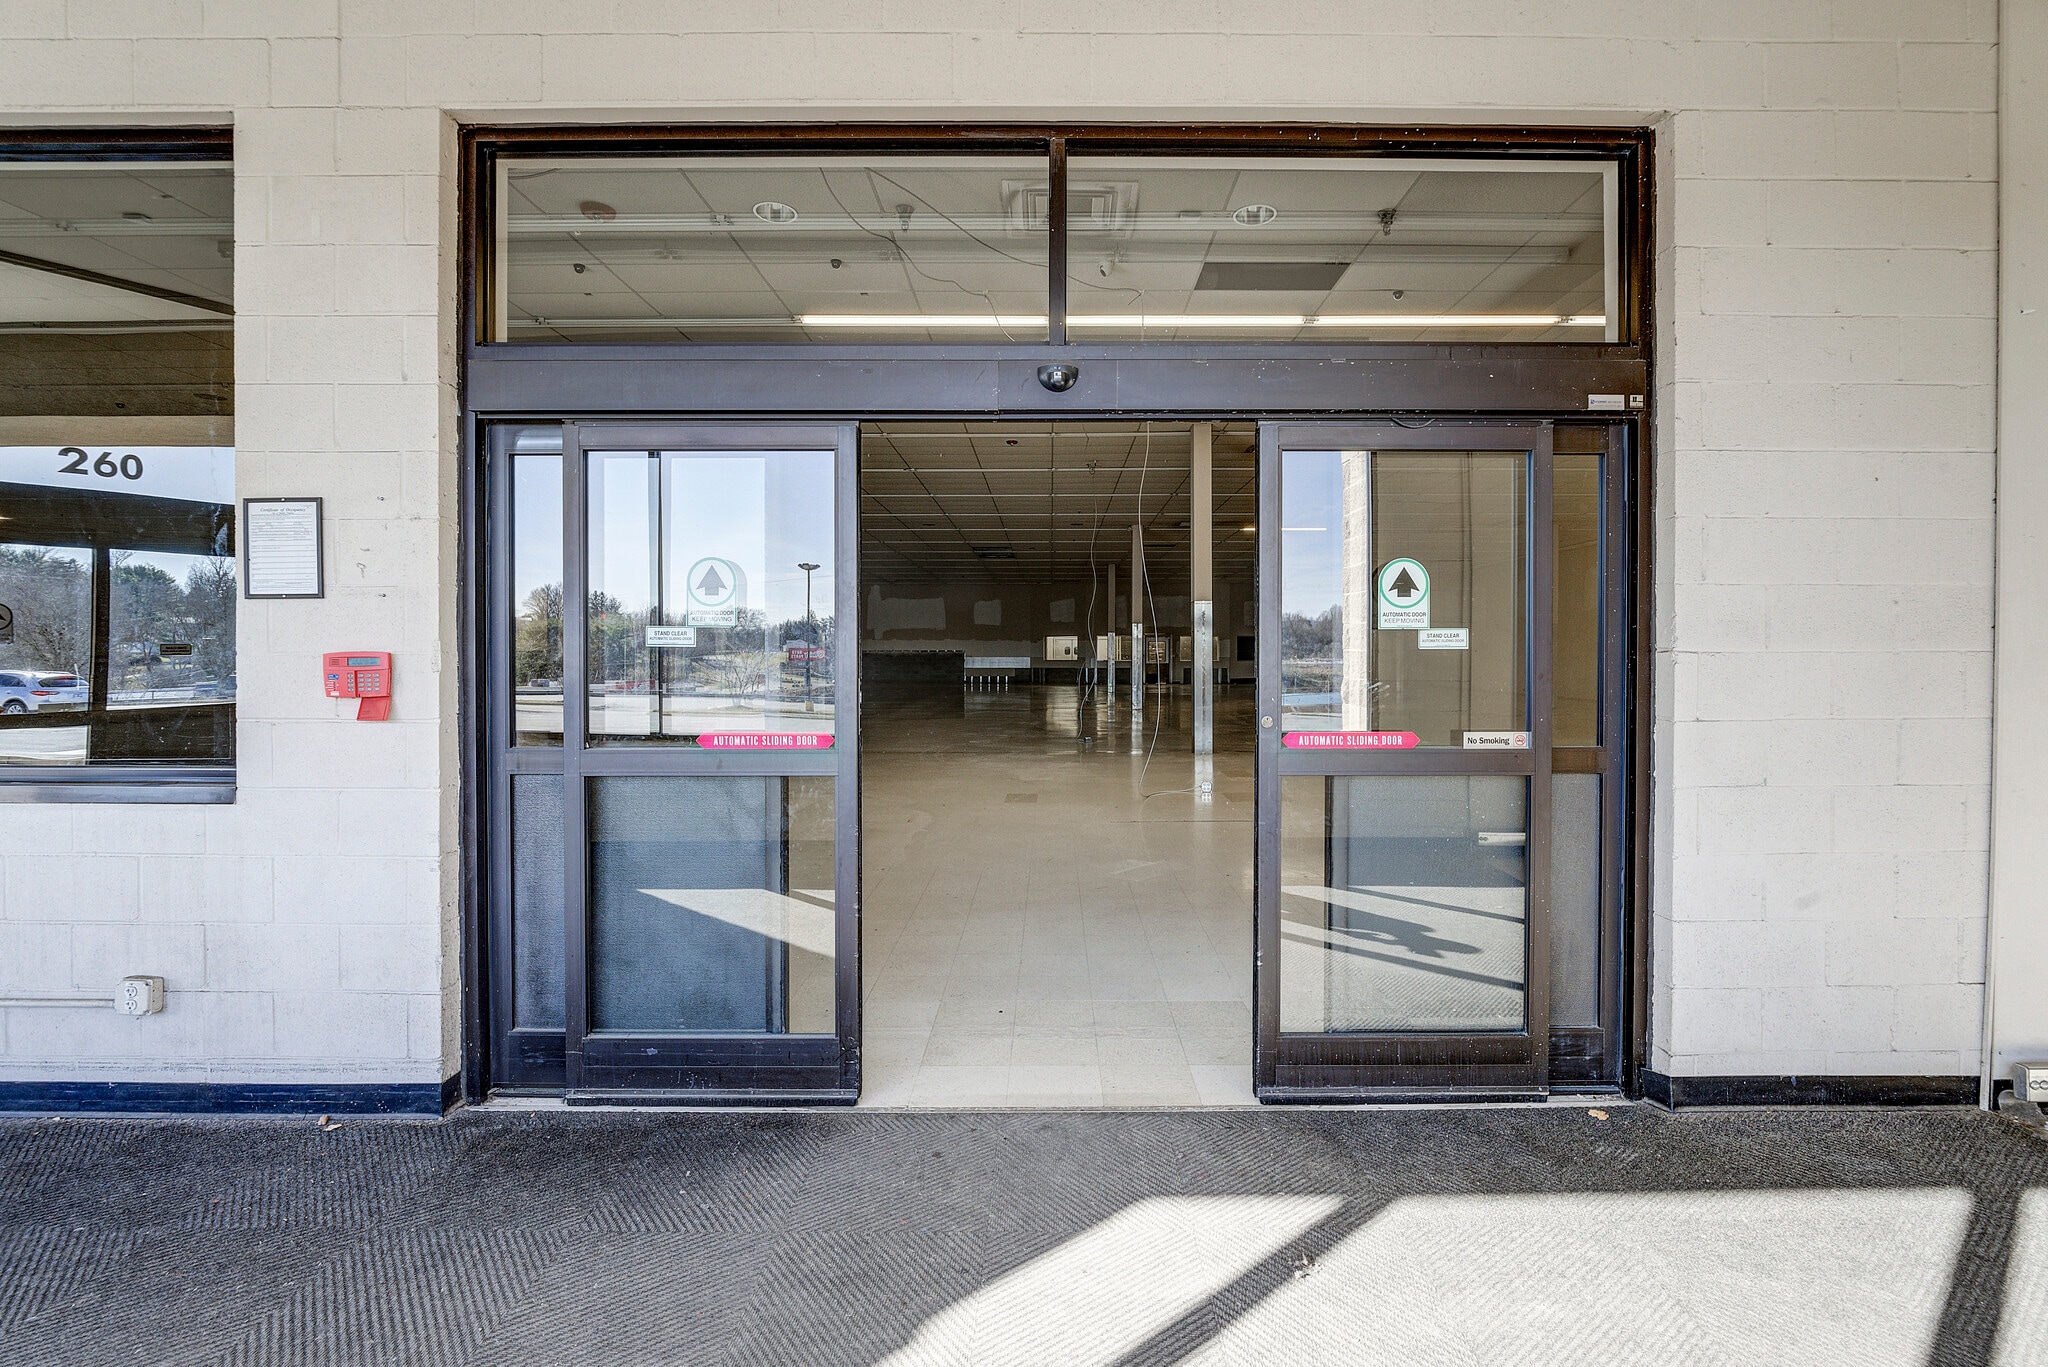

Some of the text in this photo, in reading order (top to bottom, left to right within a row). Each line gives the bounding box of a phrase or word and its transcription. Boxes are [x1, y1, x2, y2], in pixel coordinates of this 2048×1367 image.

[57, 446, 144, 480] 260
[713, 735, 818, 746] AUTOMATIC SLIDING DOOR
[1298, 735, 1403, 746] AUTOMATIC SLIDING DOOR
[1479, 737, 1510, 745] Smoking
